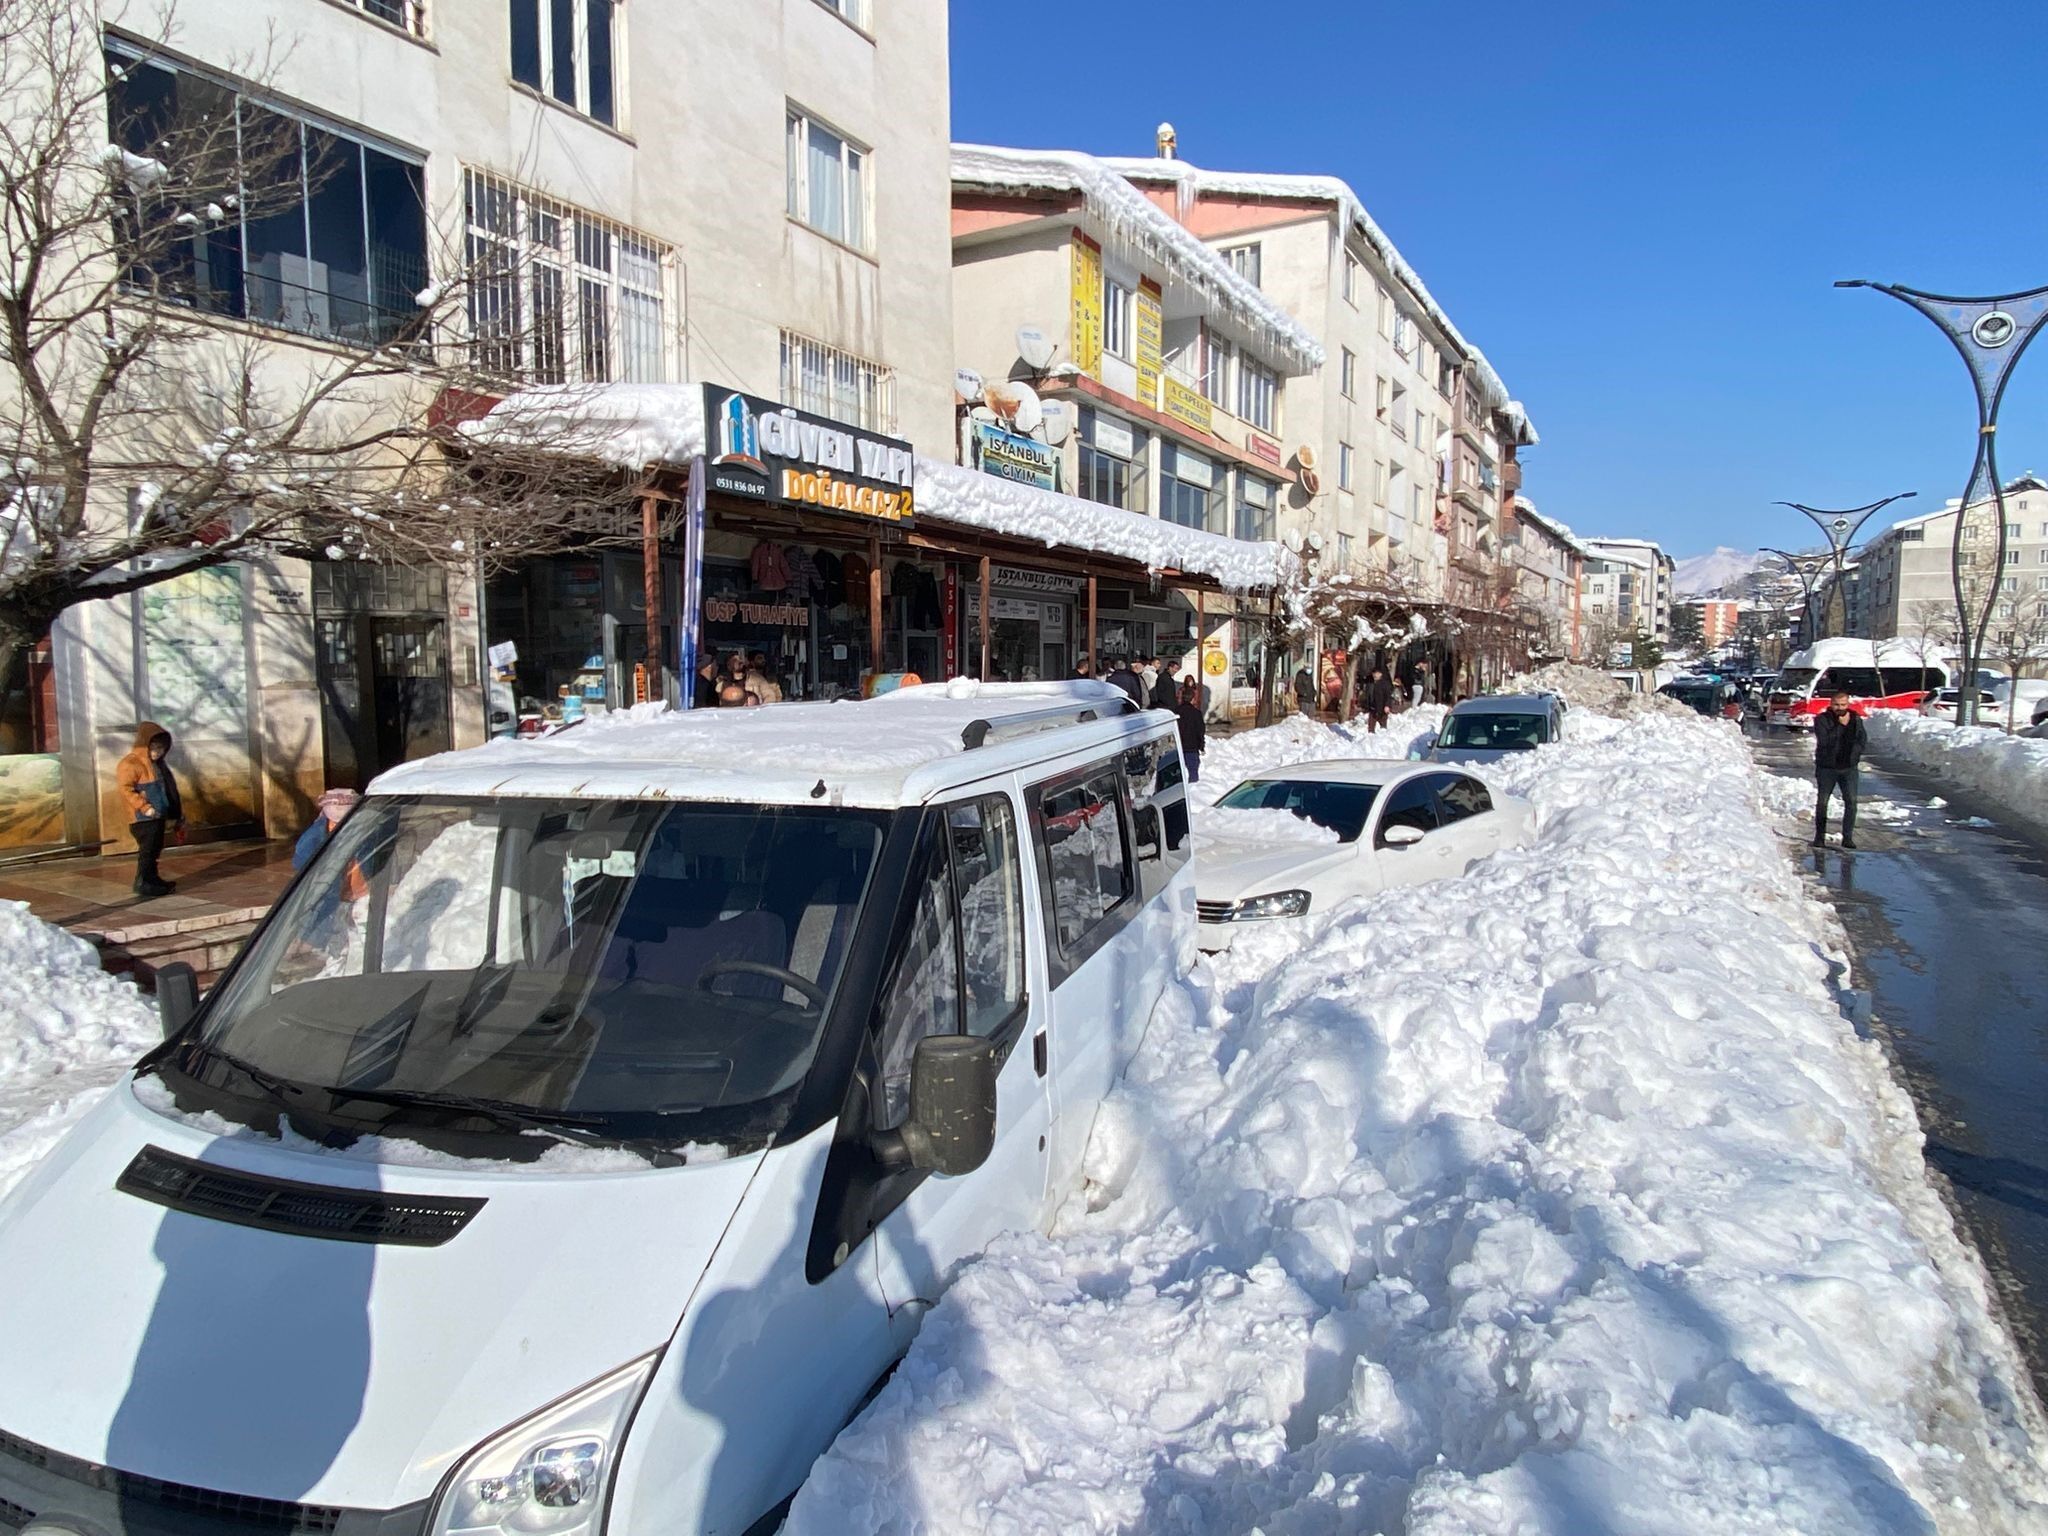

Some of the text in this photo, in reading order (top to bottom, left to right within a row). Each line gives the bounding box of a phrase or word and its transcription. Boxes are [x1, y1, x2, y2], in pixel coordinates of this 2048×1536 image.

[759, 408, 913, 488] GÜVEN YAPI
[716, 477, 733, 489] 0531
